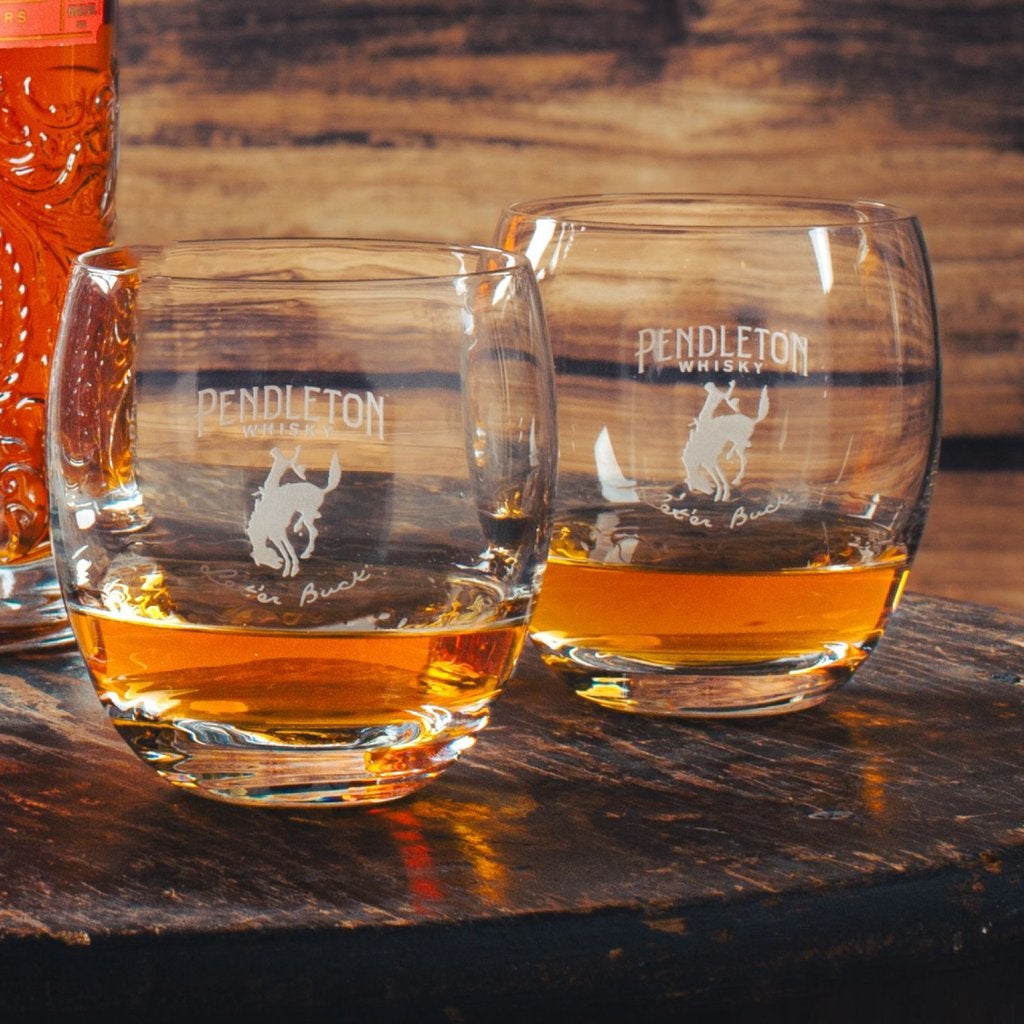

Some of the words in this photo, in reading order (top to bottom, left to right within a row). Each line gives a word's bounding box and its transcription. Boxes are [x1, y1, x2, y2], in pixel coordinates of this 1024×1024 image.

[634, 325, 809, 377] PENDLETON
[679, 360, 764, 374] WHISKY
[196, 385, 385, 440] PENDLETON
[242, 422, 334, 438] WHISKY
